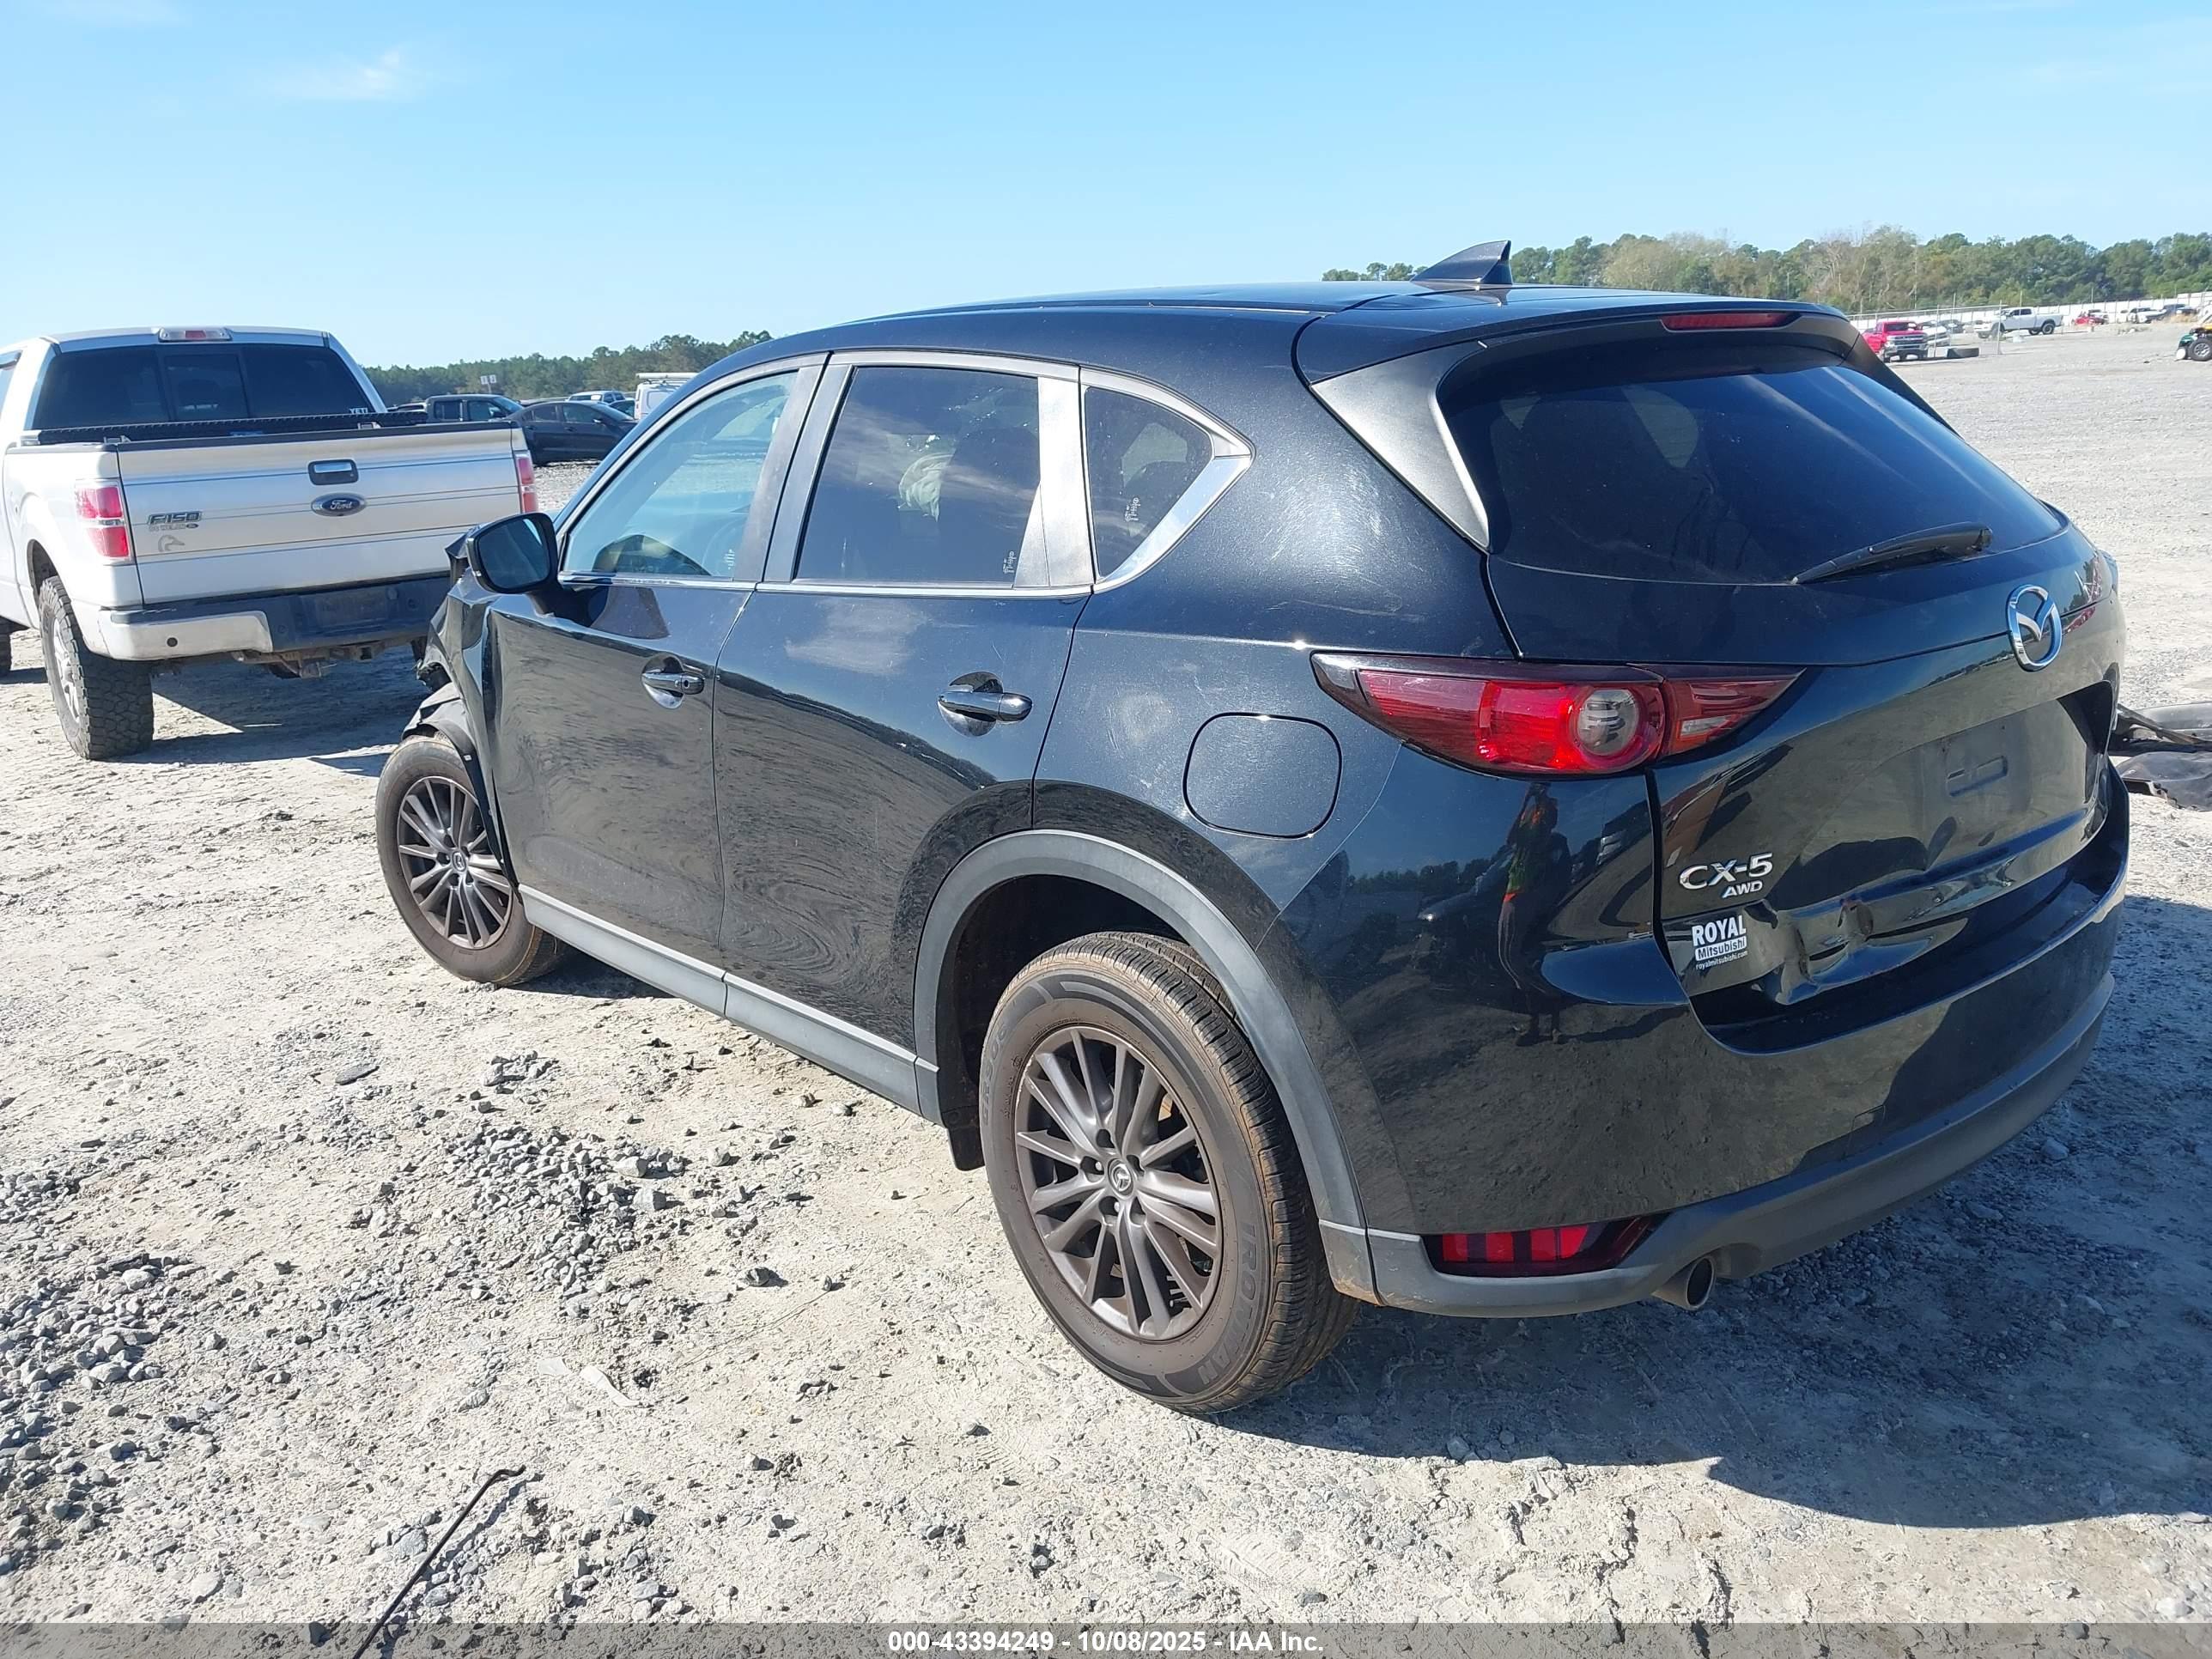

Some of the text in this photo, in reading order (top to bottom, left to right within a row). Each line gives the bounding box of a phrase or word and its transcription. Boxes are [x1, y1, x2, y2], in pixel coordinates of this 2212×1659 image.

[330, 499, 353, 510] Ford
[1679, 852, 1773, 890] CX-5
[1721, 879, 1764, 899] AWD
[1692, 915, 1747, 947] ROYAL
[1695, 950, 1748, 970] royalmitsubishi.com
[1697, 937, 1746, 960] Mitsubishi
[1197, 1224, 1258, 1386] IRONMAN
